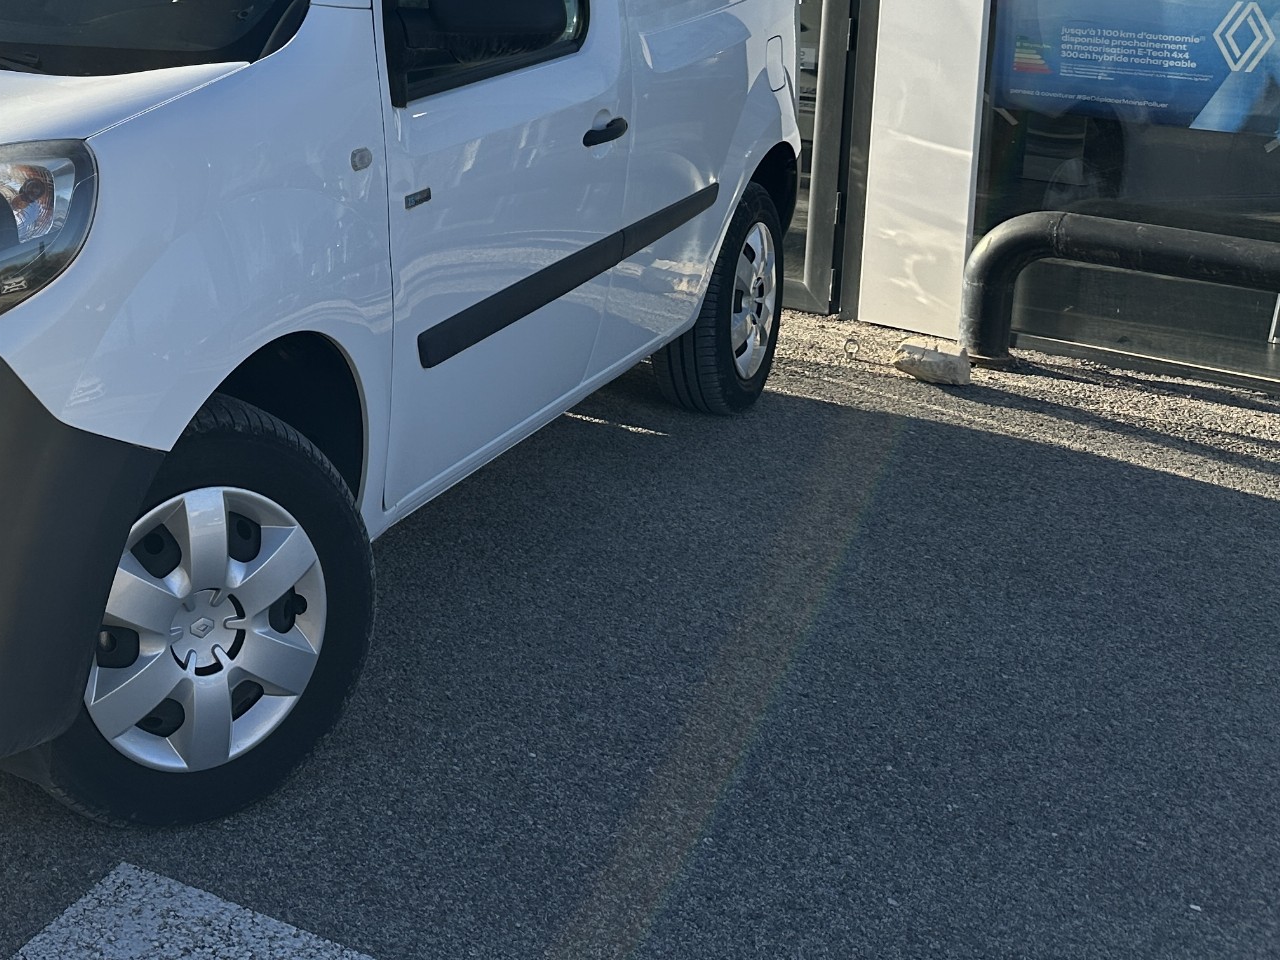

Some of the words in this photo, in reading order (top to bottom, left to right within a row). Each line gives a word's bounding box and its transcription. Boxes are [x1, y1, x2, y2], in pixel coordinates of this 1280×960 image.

[1120, 30, 1135, 39] km
[1061, 35, 1110, 46] disponible
[1111, 39, 1187, 51] prochainement
[1061, 51, 1078, 59] 300
[1079, 52, 1091, 60] ch
[1092, 53, 1129, 63] hybride
[1130, 57, 1197, 68] rechargeable
[1074, 43, 1136, 55] motorisation
[1138, 49, 1170, 58] E-Tech
[1171, 51, 1190, 60] 4x4
